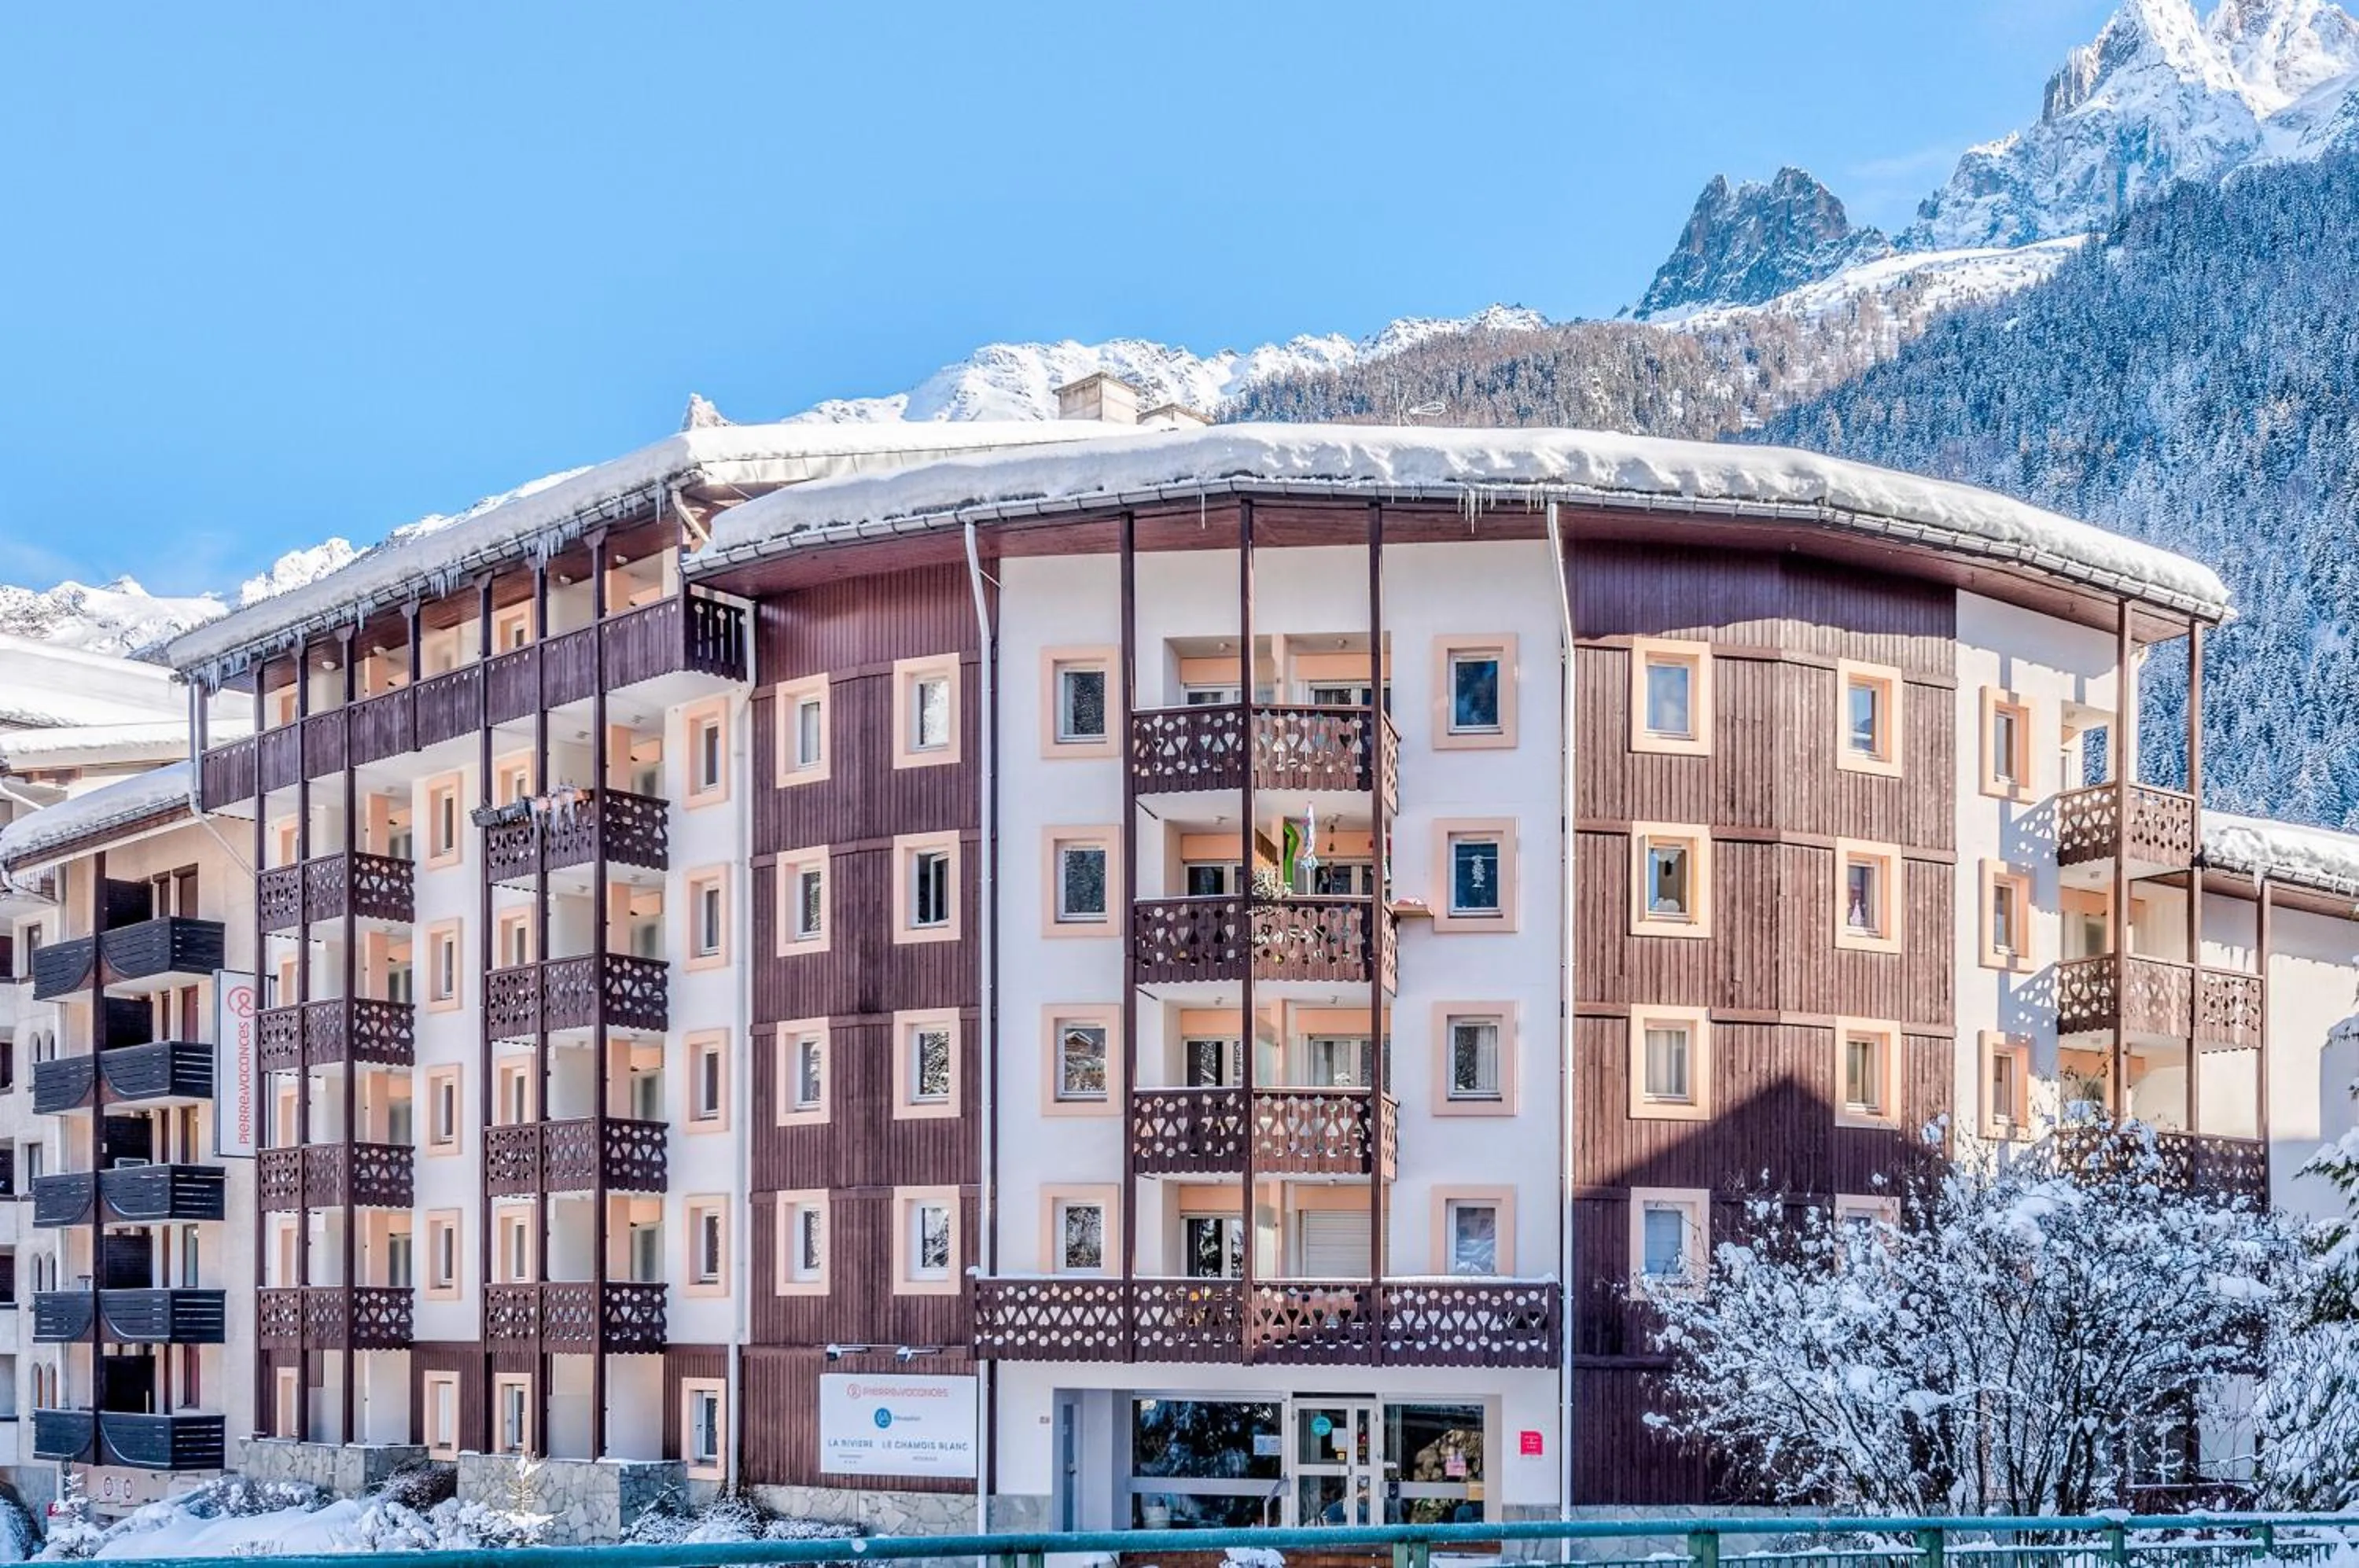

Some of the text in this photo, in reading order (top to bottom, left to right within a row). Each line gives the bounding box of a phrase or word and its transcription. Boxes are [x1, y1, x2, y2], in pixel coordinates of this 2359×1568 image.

[828, 1439, 838, 1448] LA
[881, 1441, 969, 1452] LE CHAMOIS BLANC
